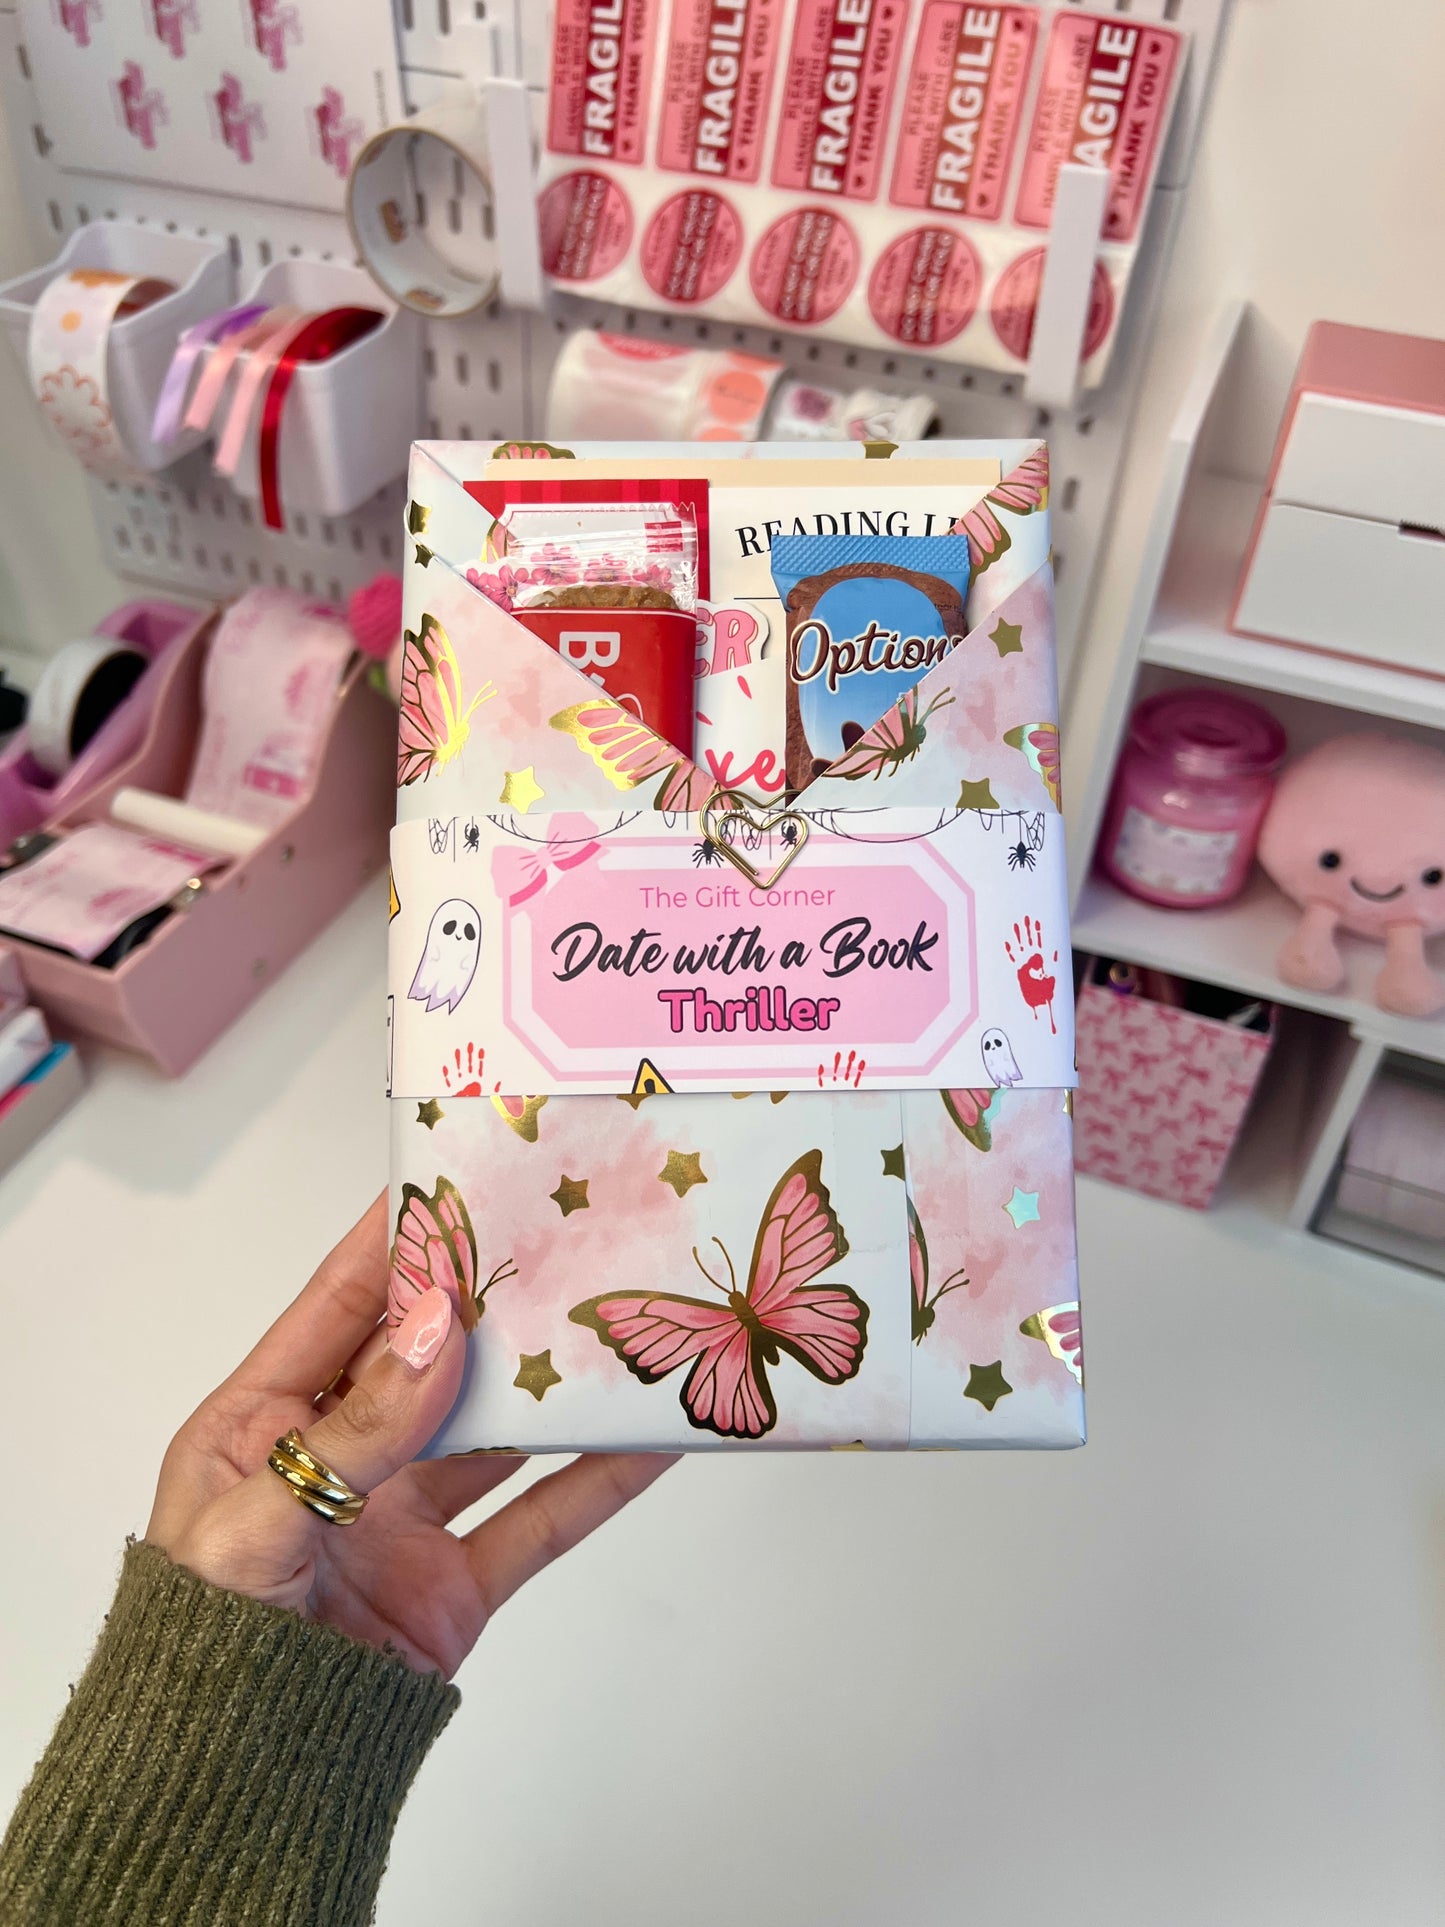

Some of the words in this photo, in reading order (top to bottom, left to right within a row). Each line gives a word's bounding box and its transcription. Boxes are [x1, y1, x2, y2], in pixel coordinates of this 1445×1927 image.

[583, 0, 623, 155] FRAGIL
[811, 0, 871, 190] FRAGILE
[856, 86, 883, 162] THANK
[873, 28, 892, 73] YOU
[931, 8, 999, 210] FRAGILE
[981, 101, 1010, 181] THANK
[1003, 43, 1021, 88] YOU
[1073, 24, 1138, 169] AGILE
[1114, 120, 1145, 200] THANK
[1135, 63, 1160, 112] YOU
[735, 511, 910, 557] READING
[551, 921, 670, 982] Date
[672, 925, 775, 976] with
[780, 941, 812, 970] a
[819, 916, 939, 979] Book
[640, 887, 688, 908] The
[695, 886, 741, 908] Gift
[749, 885, 836, 907] Corner
[657, 985, 841, 1034] Thriller
